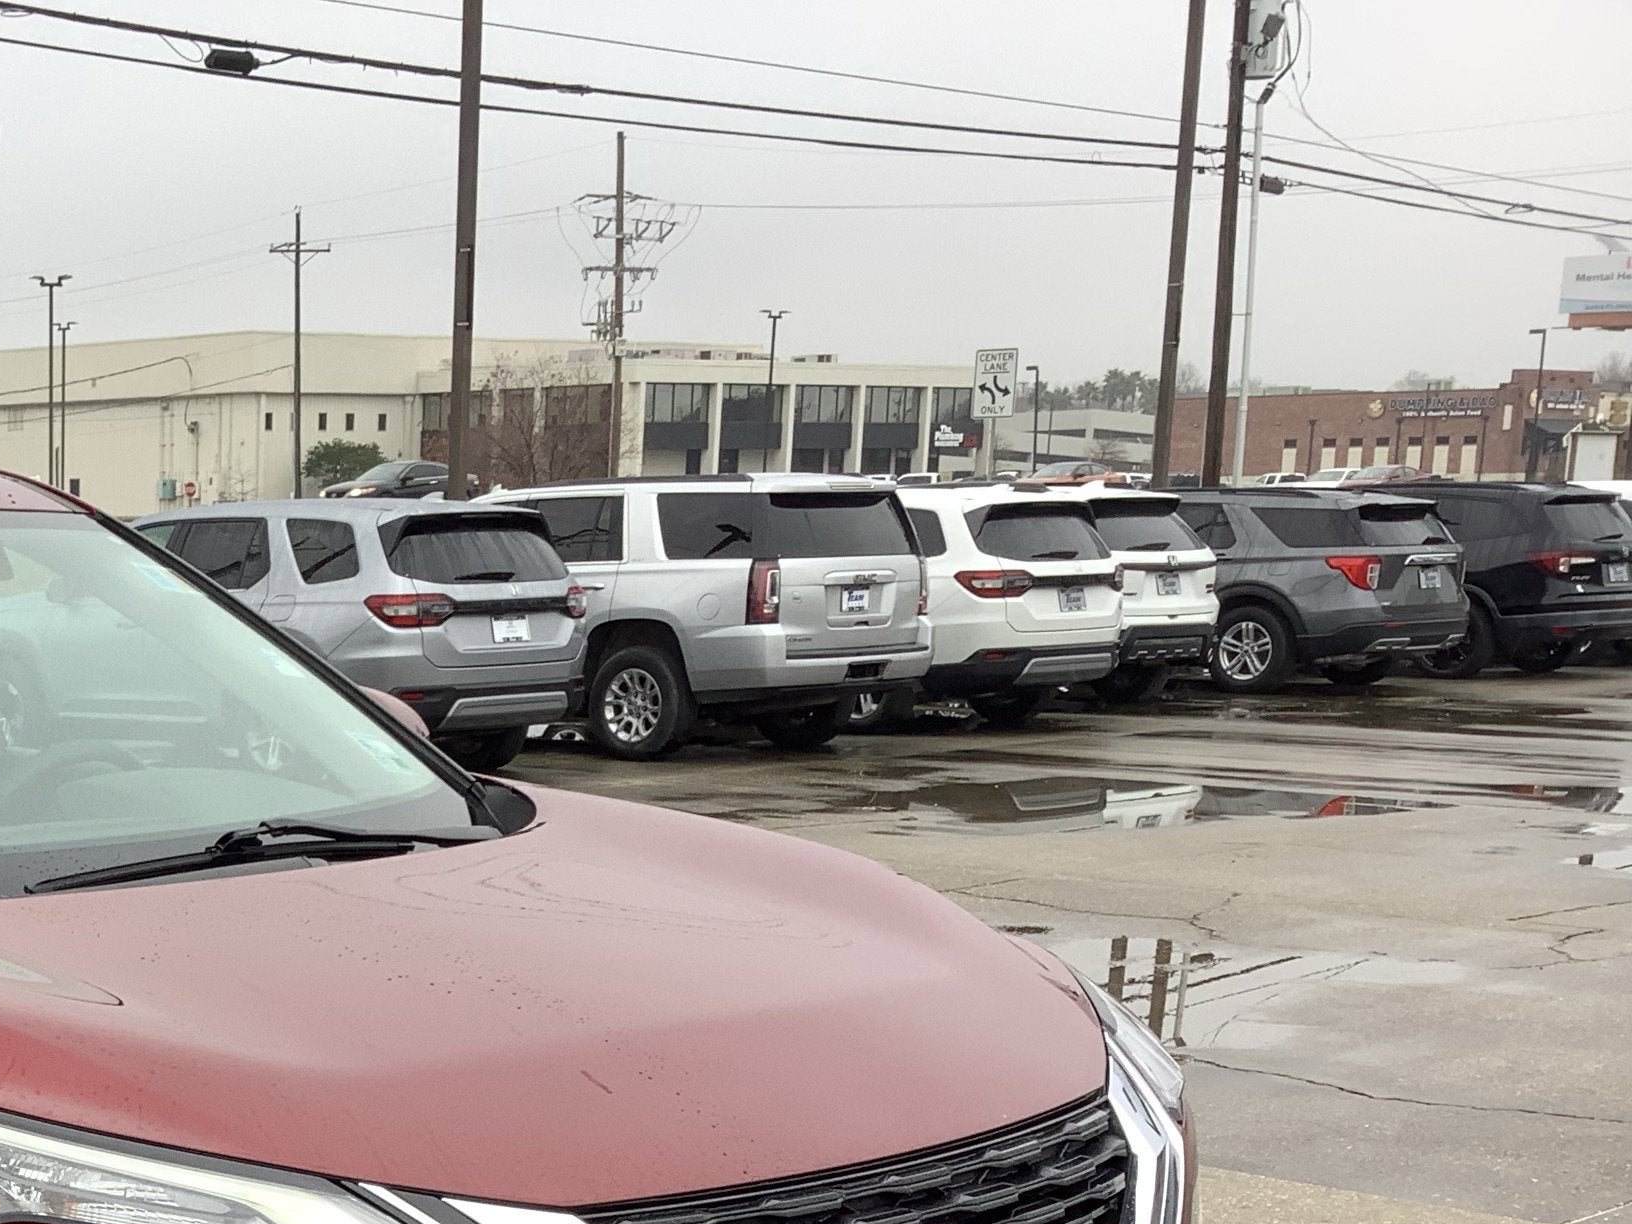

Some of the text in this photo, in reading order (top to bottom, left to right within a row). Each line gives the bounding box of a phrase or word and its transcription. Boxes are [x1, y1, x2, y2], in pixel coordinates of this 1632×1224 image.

[1575, 272, 1615, 282] Mental
[979, 352, 1014, 362] CENTER
[983, 362, 1008, 371] LANE
[1388, 397, 1455, 410] DUMPING
[980, 405, 1005, 415] ONLY
